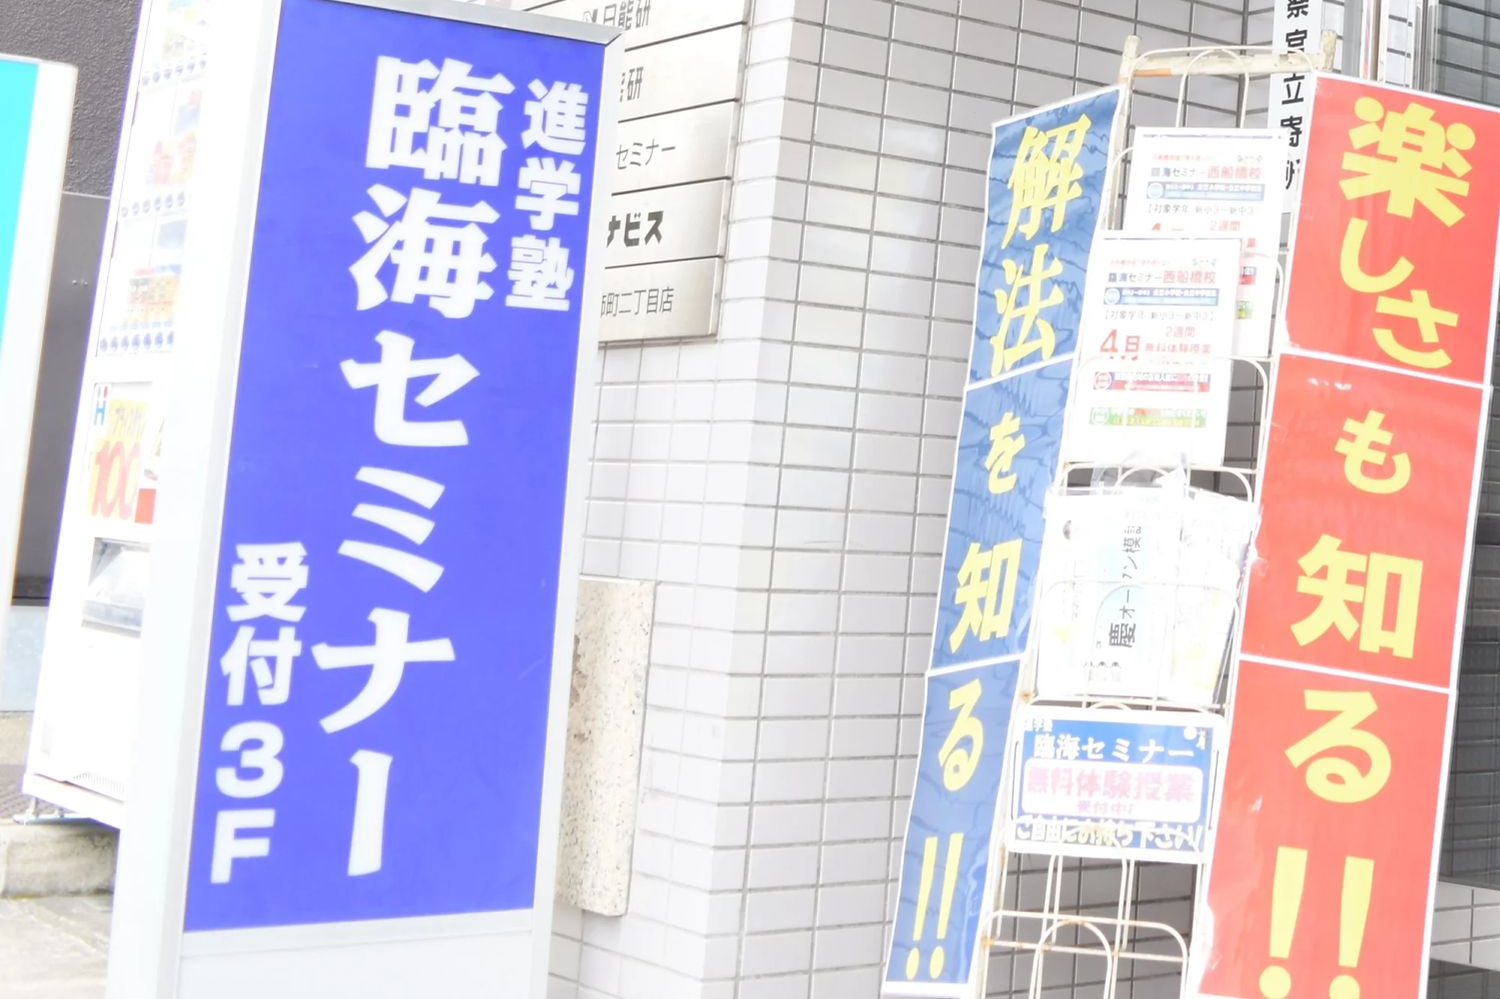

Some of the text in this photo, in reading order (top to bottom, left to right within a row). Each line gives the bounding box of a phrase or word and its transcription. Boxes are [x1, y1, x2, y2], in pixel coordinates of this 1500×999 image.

[615, 138, 676, 170] セミナー
[505, 79, 589, 311] 進学塾
[311, 55, 514, 876] 臨海セミナー
[1033, 732, 1195, 764] 臨海セミナー
[1027, 766, 1195, 804] 無料体験授業
